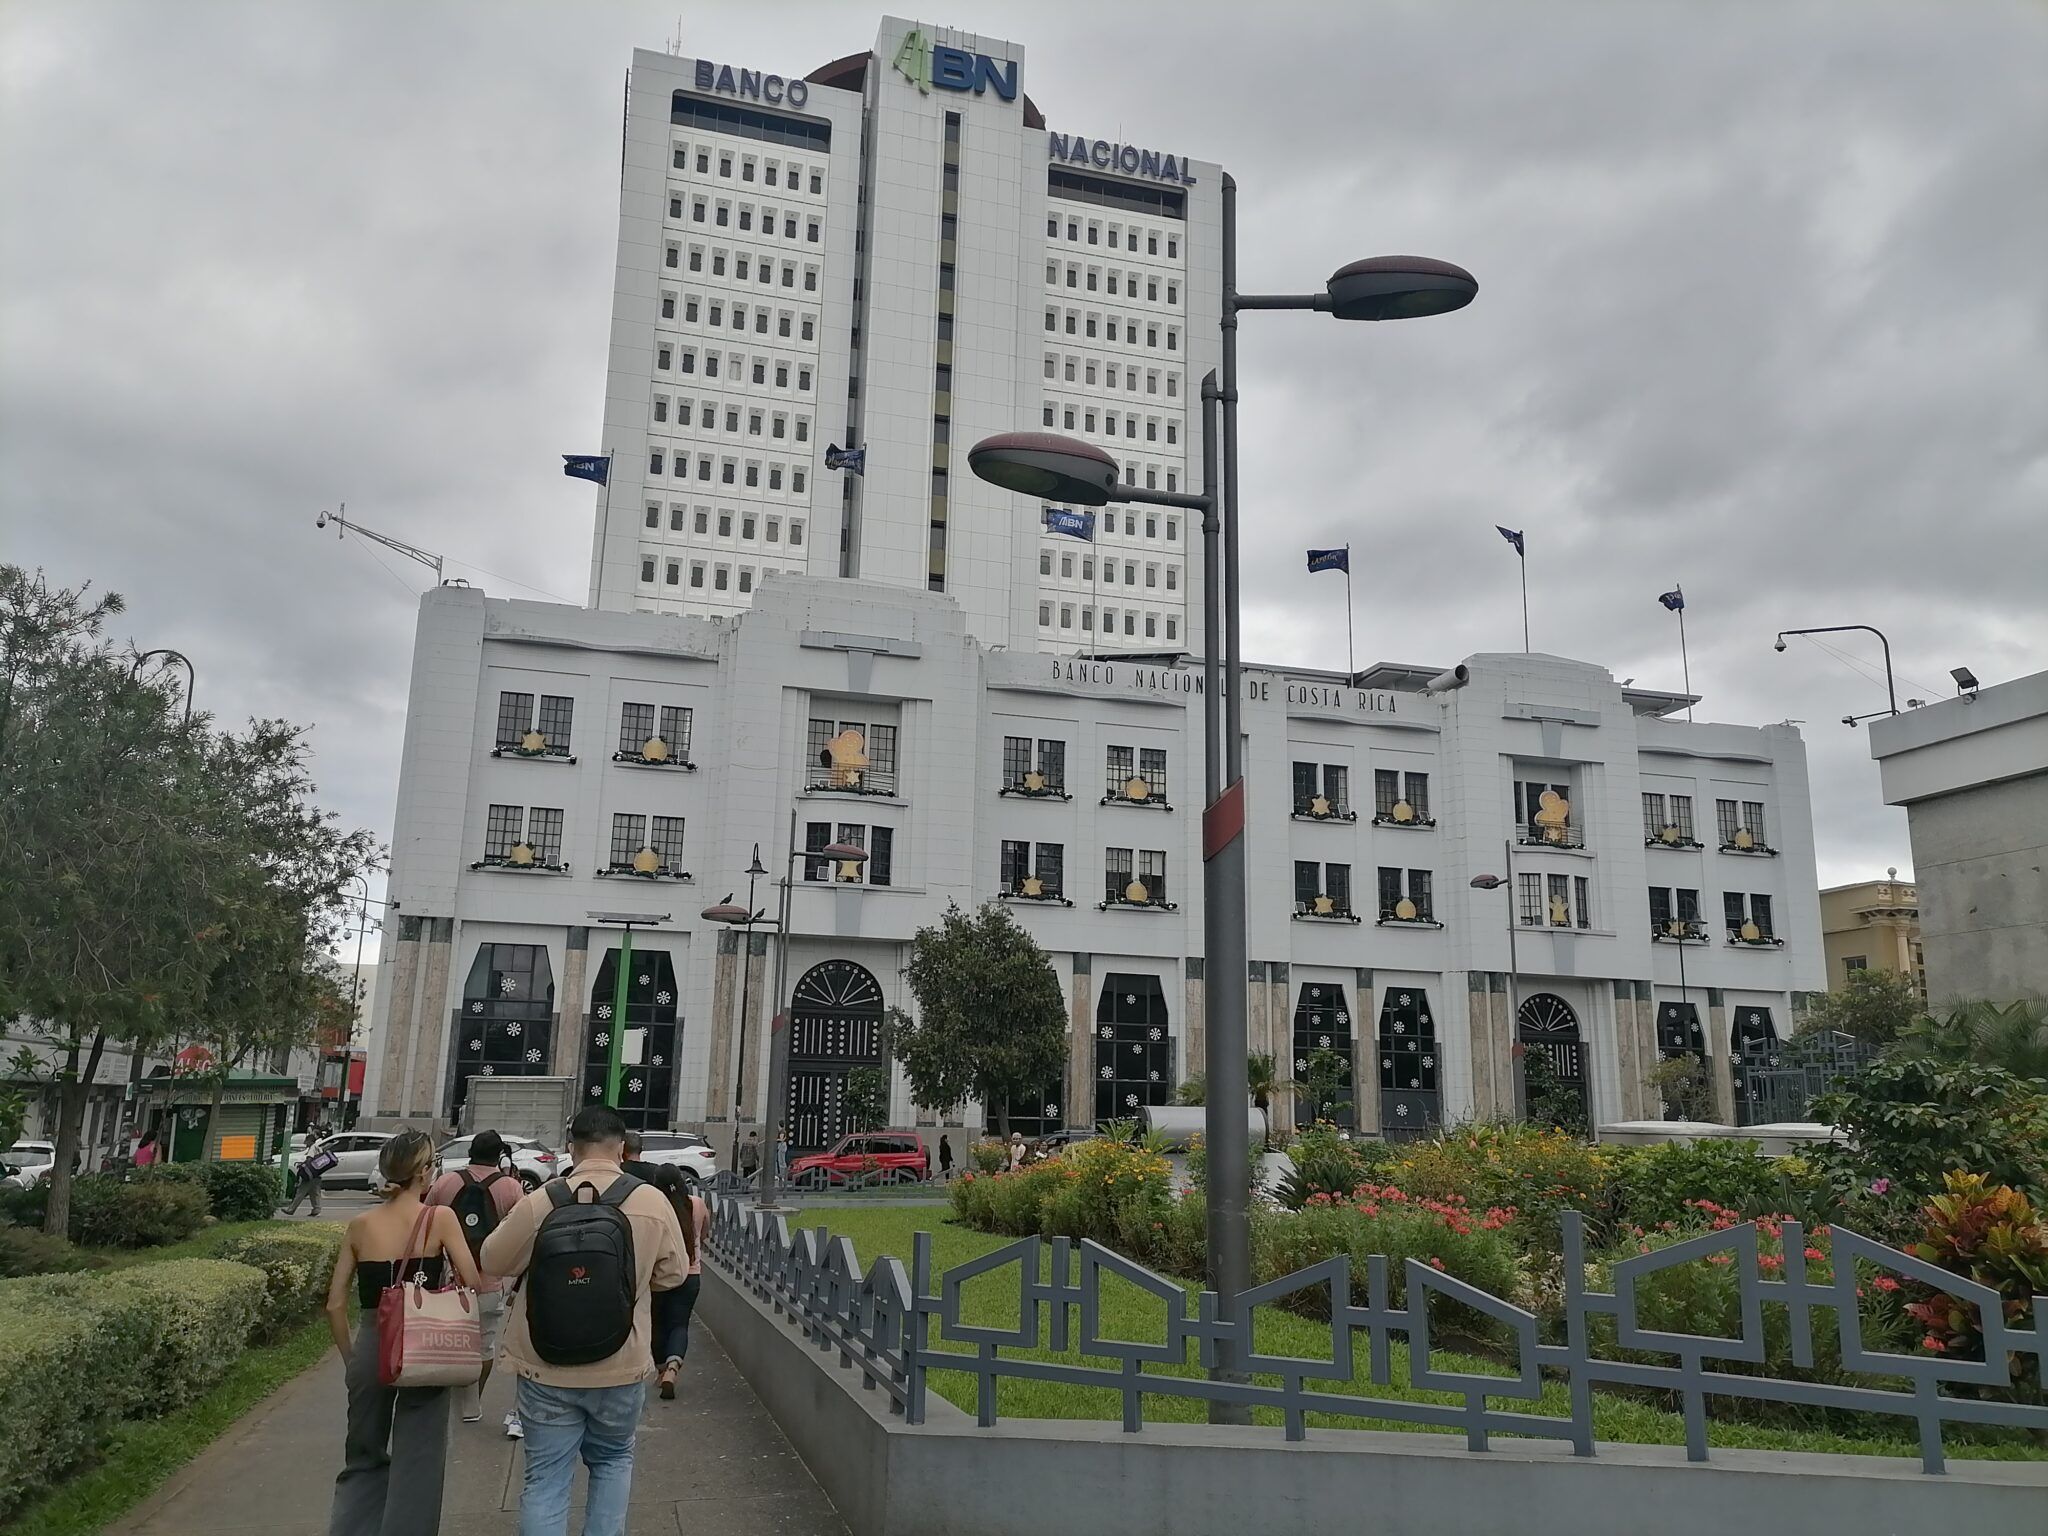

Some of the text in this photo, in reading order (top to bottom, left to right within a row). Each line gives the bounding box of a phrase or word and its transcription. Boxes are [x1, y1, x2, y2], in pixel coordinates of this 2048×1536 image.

[695, 59, 808, 108] BANCO
[934, 45, 1017, 100] BN
[1050, 131, 1197, 184] NACIONAL
[1052, 660, 1396, 713] BANCO NACIONL DE COSTA RICA
[422, 1332, 472, 1348] HUSER
